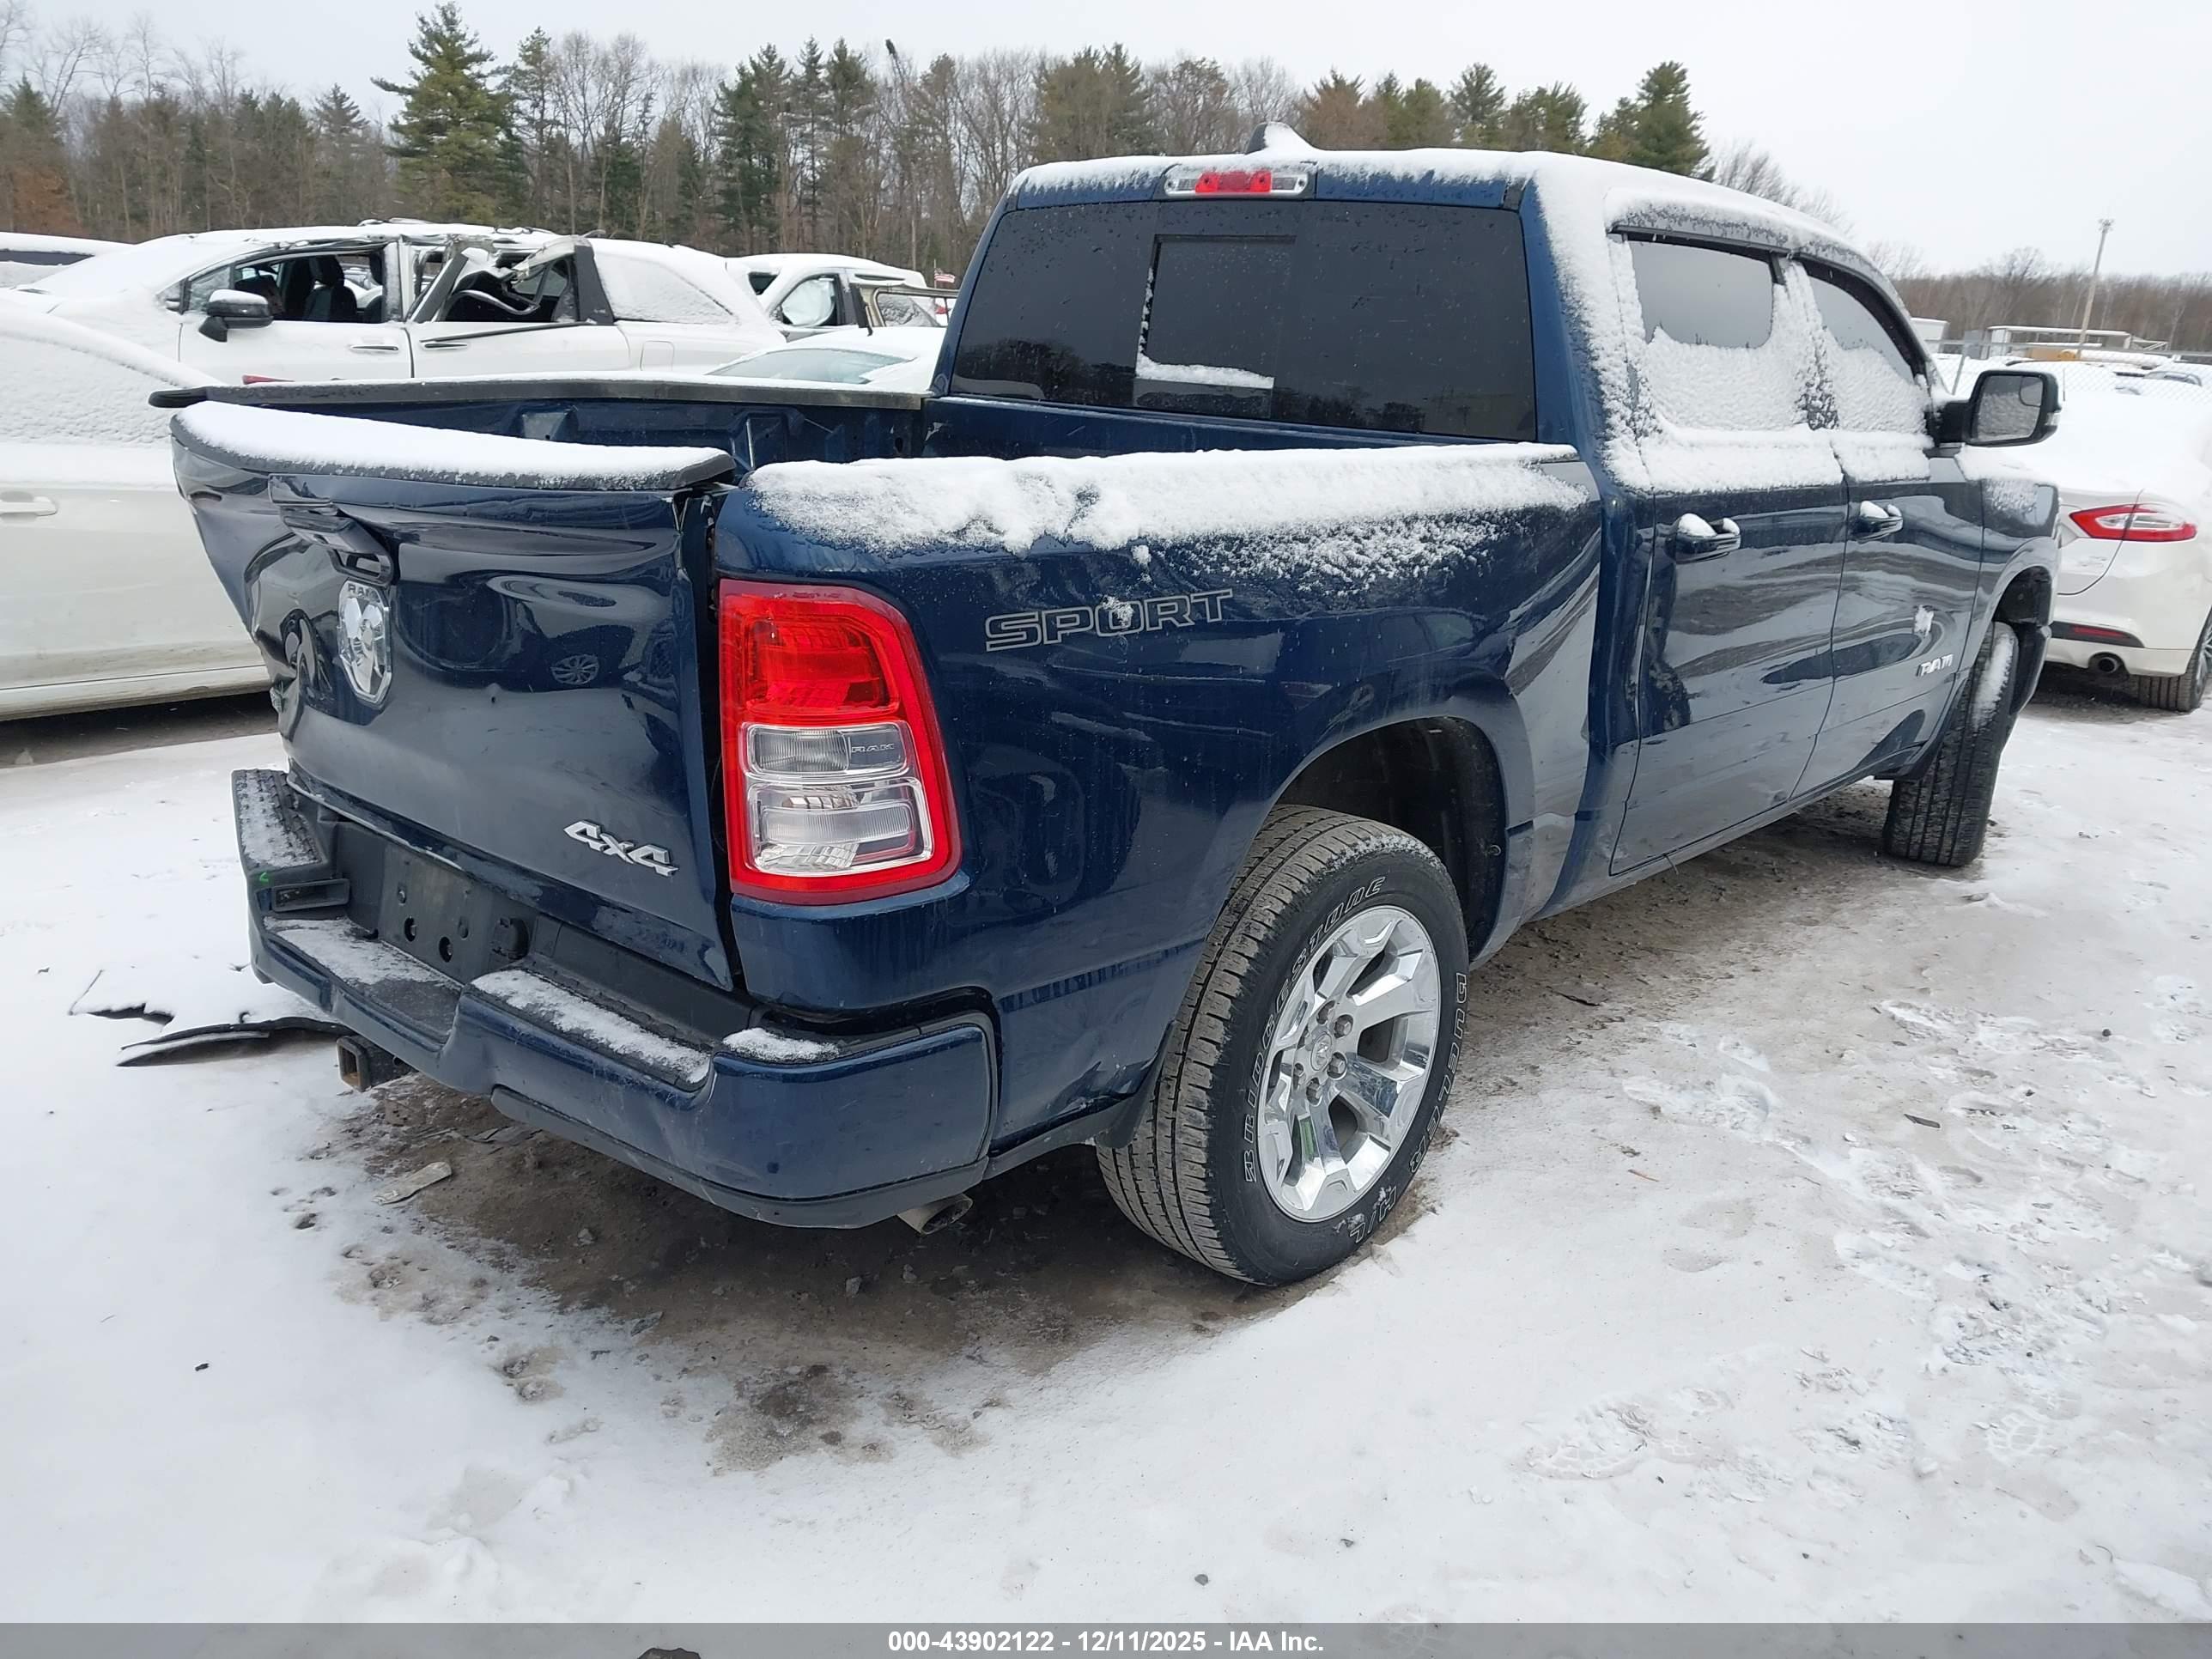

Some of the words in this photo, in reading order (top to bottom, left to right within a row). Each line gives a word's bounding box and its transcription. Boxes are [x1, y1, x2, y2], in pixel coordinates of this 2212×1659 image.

[985, 588, 1233, 652] SPORT
[1920, 653, 1954, 676] RAM
[851, 743, 895, 753] RAM
[1244, 876, 1386, 1183] BRIDGESTONE
[1409, 972, 1468, 1173] DUELER
